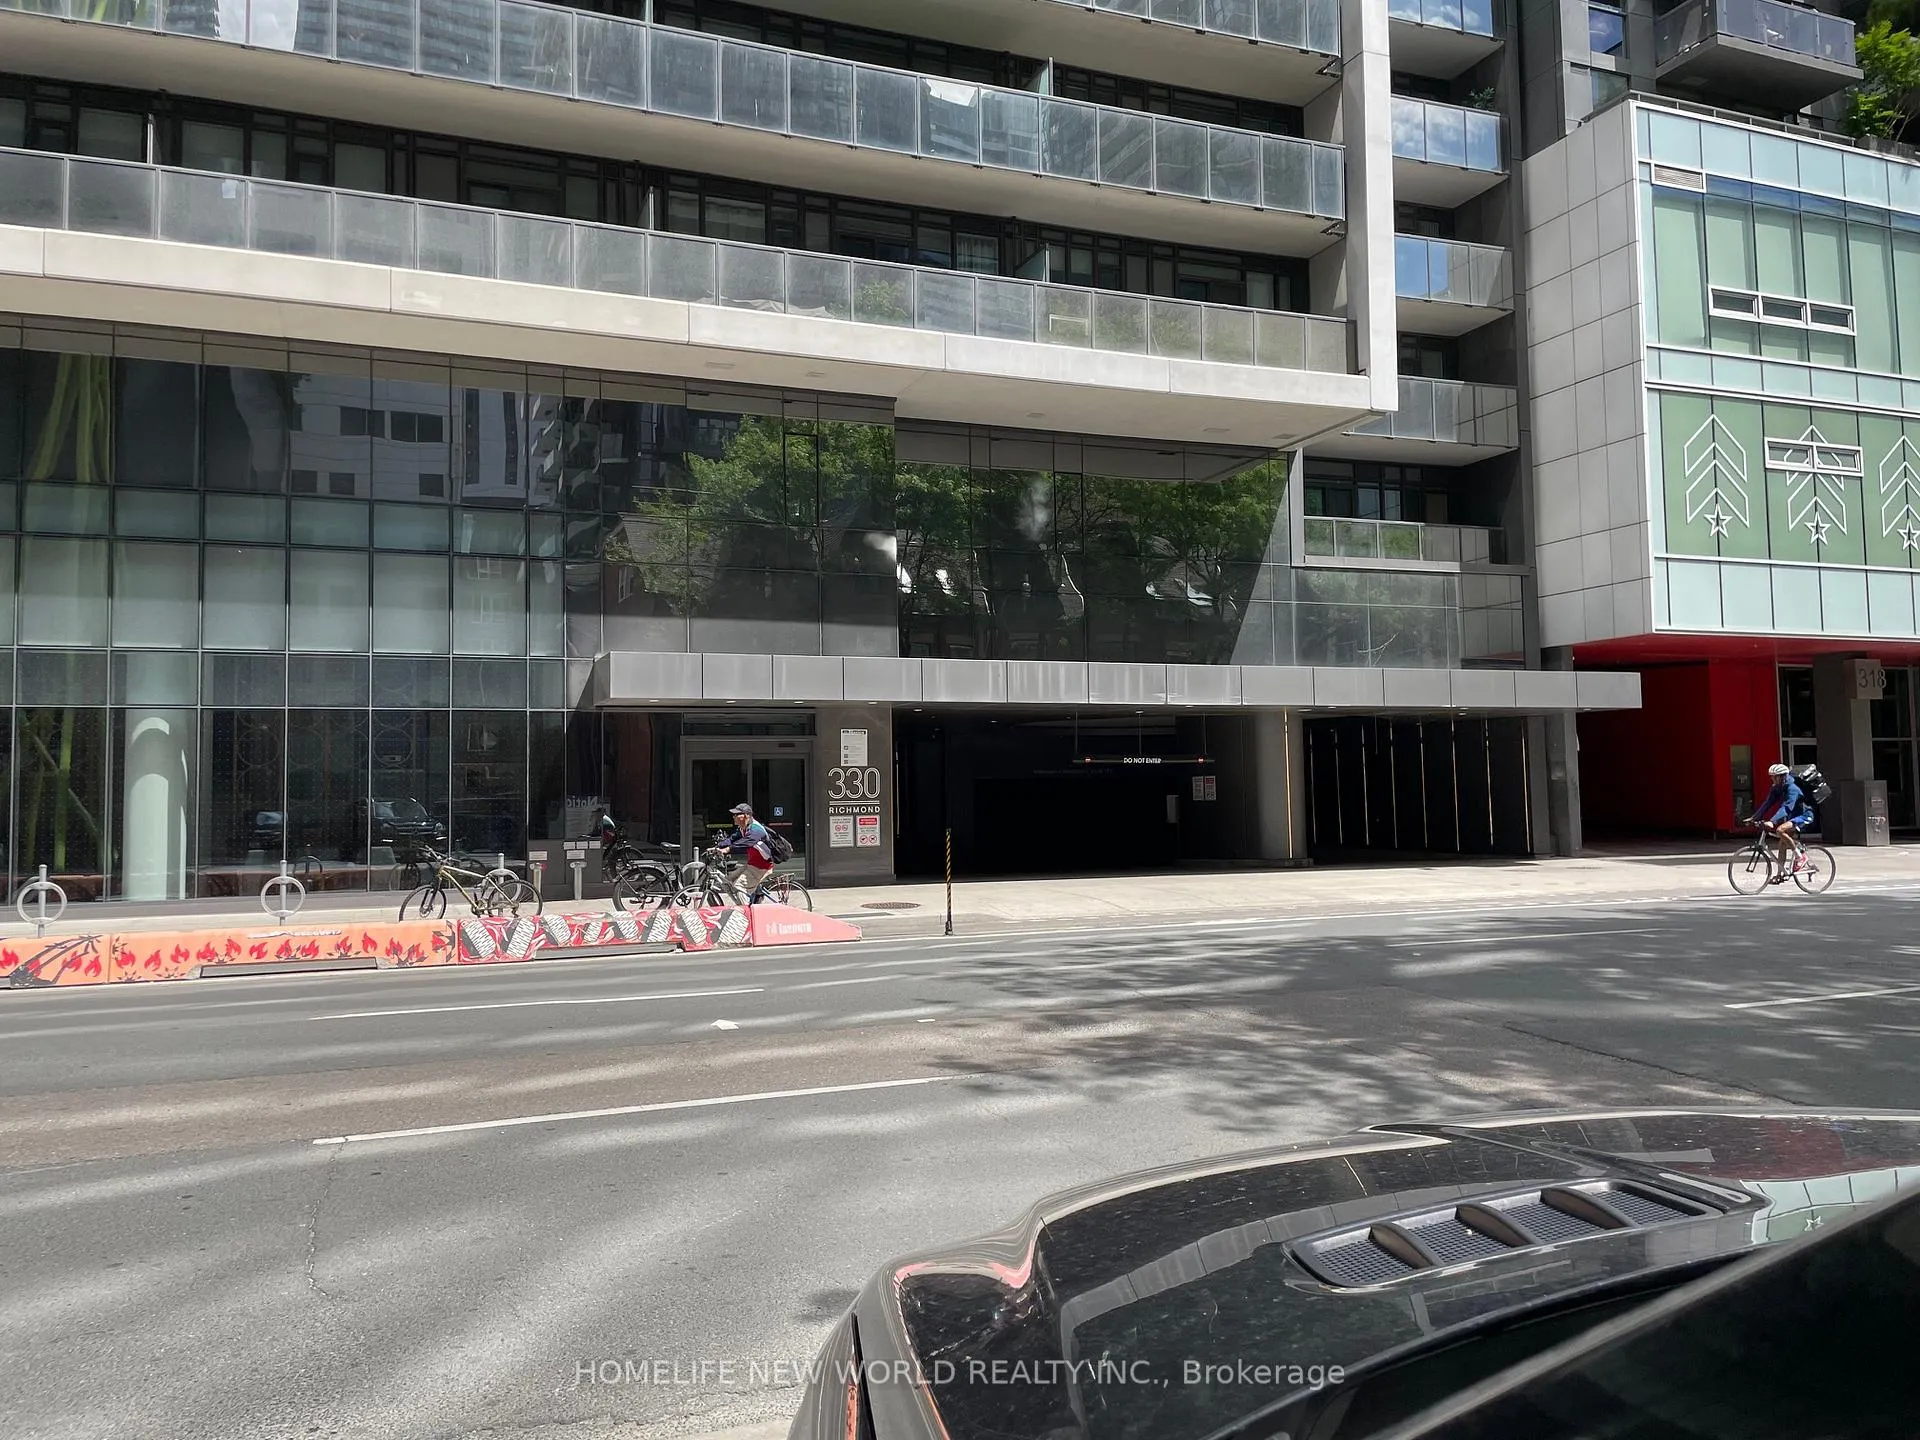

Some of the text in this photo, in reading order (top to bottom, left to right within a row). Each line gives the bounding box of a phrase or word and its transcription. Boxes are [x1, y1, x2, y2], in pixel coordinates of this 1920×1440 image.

[1858, 668, 1887, 689] 318
[828, 767, 881, 799] 330
[829, 806, 881, 814] RICHMOND
